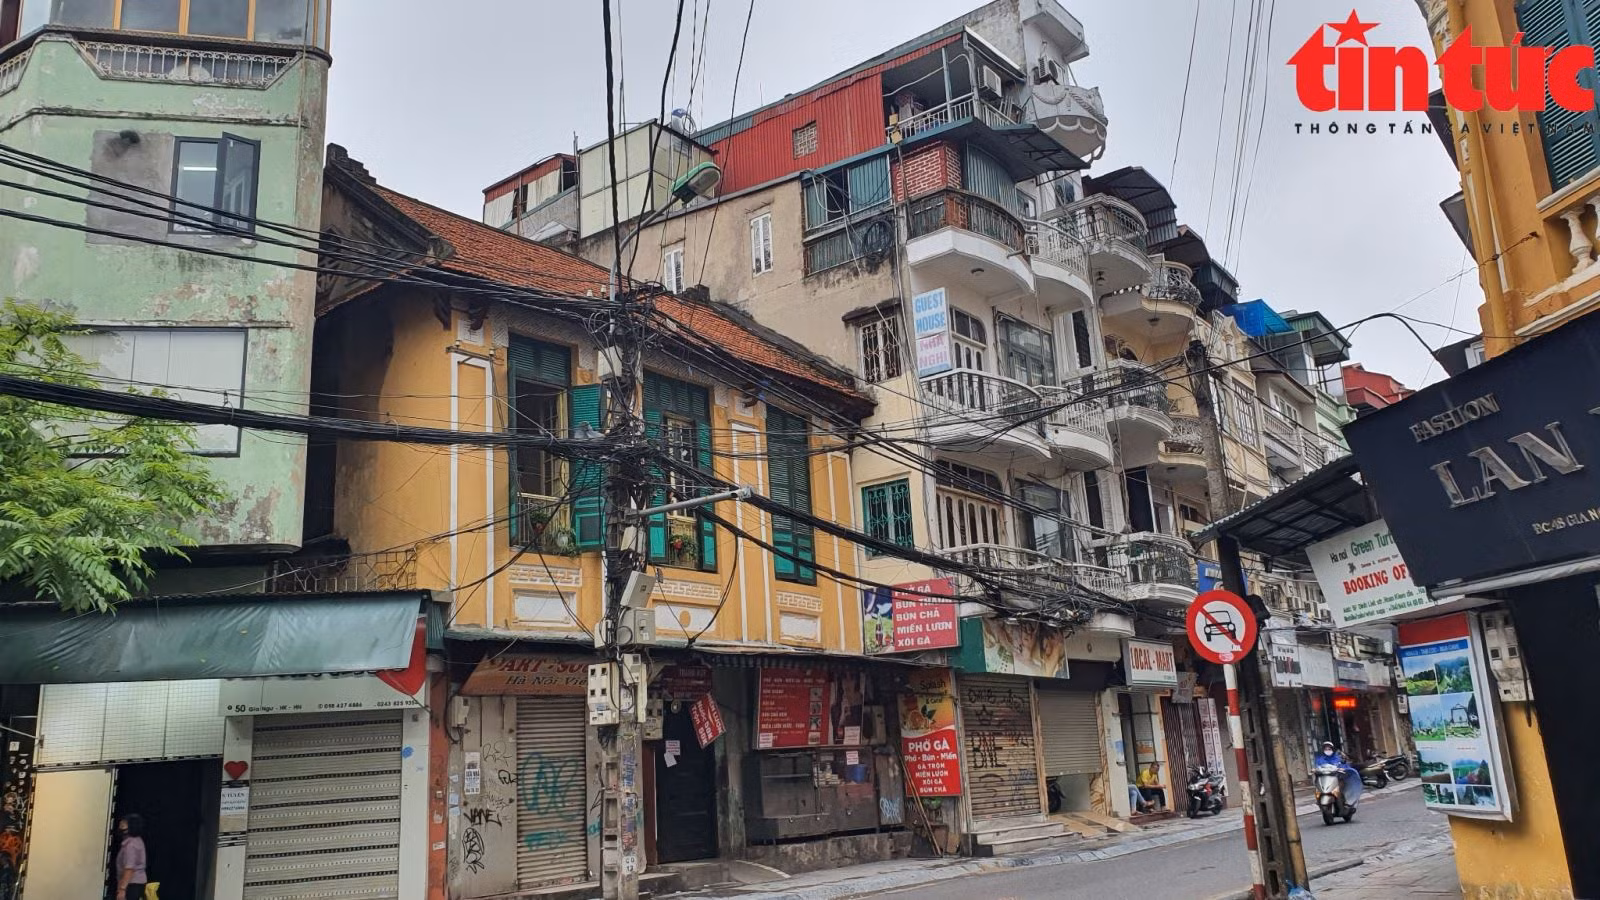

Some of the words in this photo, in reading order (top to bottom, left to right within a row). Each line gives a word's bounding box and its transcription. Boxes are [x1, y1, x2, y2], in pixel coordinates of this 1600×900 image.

[914, 291, 944, 313] GUEST
[915, 312, 946, 333] HOUSE
[1409, 393, 1500, 443] FASHION
[1429, 421, 1585, 508] LAN
[1566, 511, 1590, 527] GIA
[1350, 538, 1375, 557] Green
[917, 584, 931, 593] GÀ
[1343, 569, 1389, 595] BOOKING
[896, 612, 917, 621] BÚN
[920, 607, 940, 619] CHẢ
[897, 638, 914, 647] XÔI
[917, 636, 931, 645] GÀ
[1130, 647, 1152, 671] LOCAL
[1155, 650, 1174, 673] MART
[506, 676, 526, 685] Hà
[234, 705, 246, 713] 50
[908, 738, 931, 752] PHỞ
[933, 736, 950, 751] GÀ
